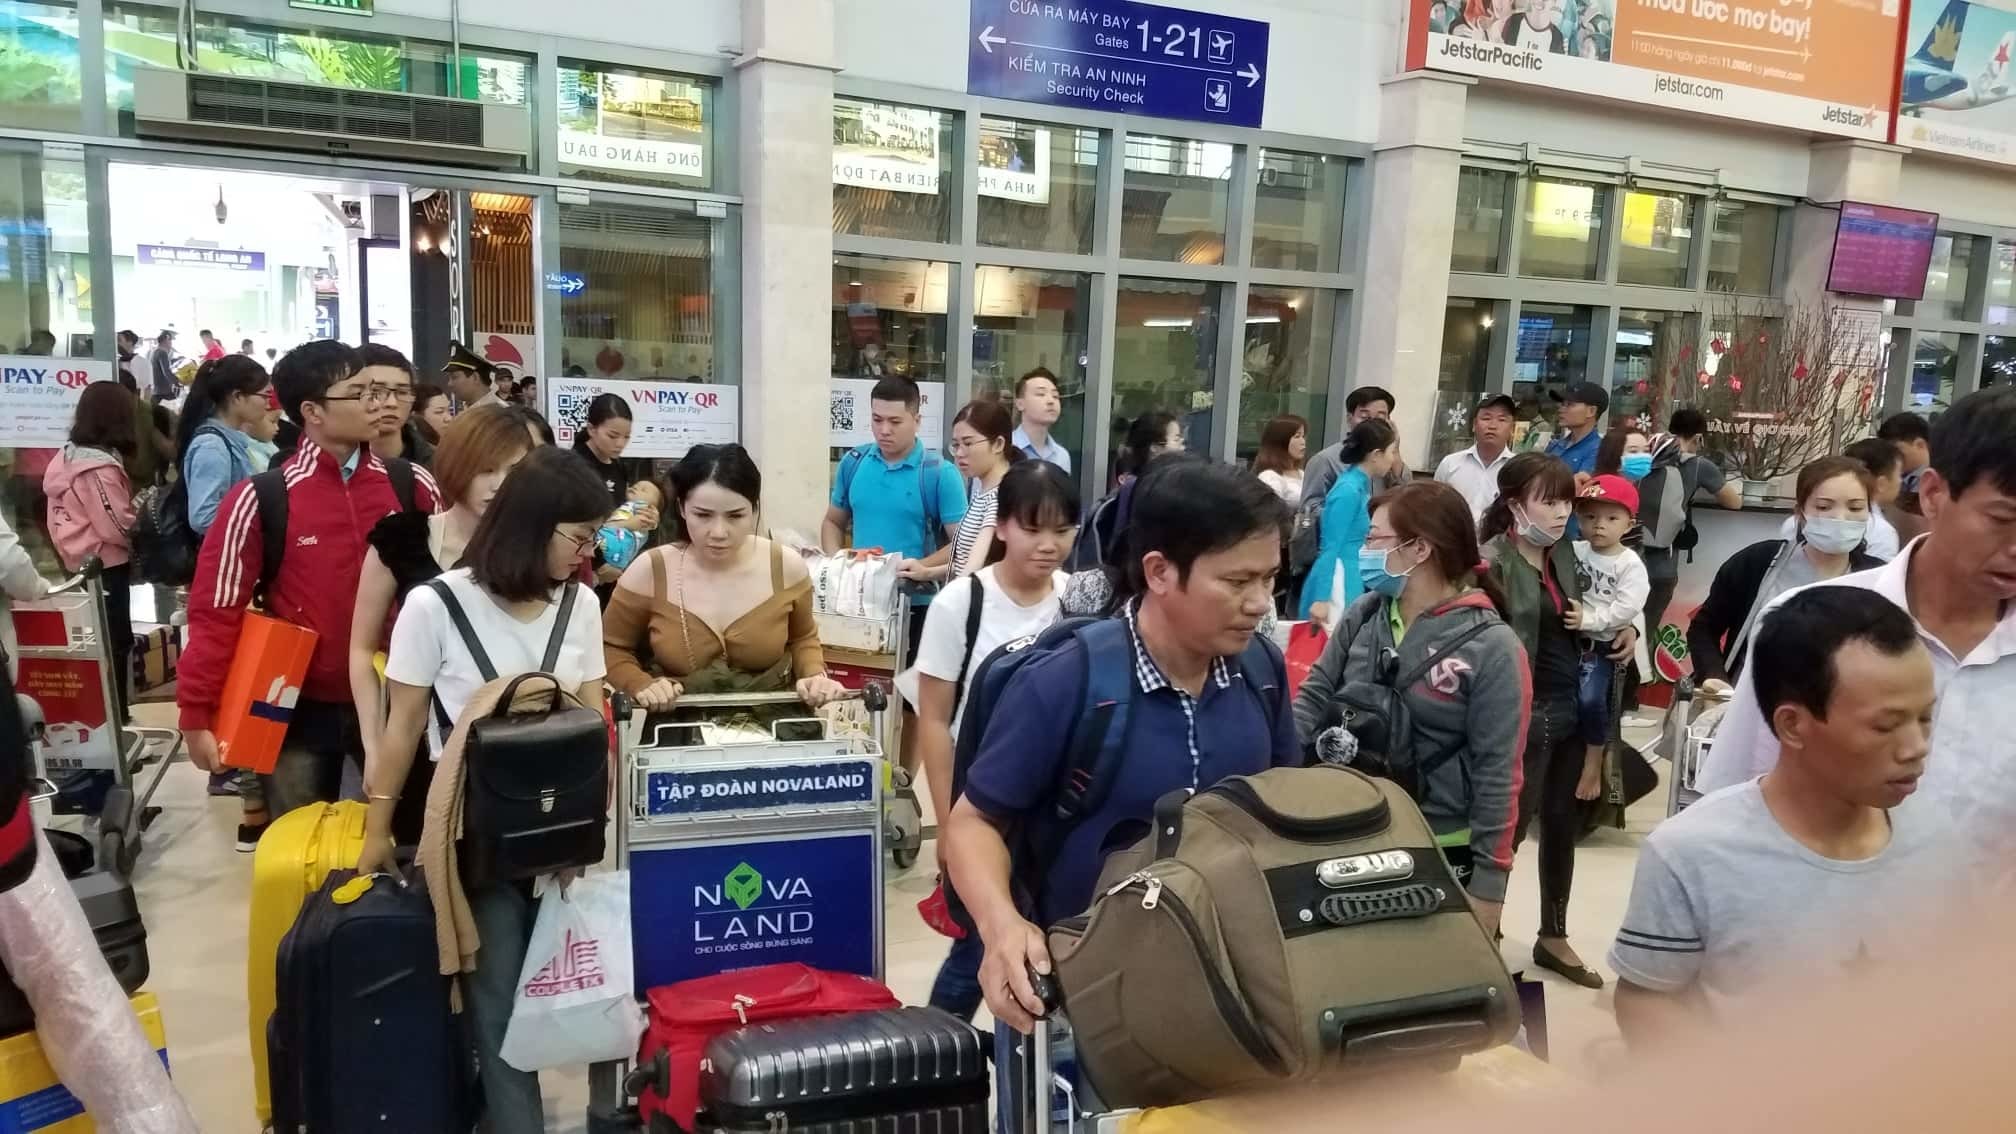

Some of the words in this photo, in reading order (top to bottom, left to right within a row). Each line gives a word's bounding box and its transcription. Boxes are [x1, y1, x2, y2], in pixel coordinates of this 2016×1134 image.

[1045, 5, 1063, 20] RA
[1068, 8, 1098, 25] MÁY
[1103, 14, 1130, 30] BAY
[1769, 8, 1811, 43] bay!
[1095, 33, 1129, 49] Gates
[1137, 20, 1201, 59] 1-21
[1441, 39, 1542, 70] JetstarPacific
[1052, 62, 1081, 78] TRA
[1085, 67, 1106, 81] AN
[1111, 71, 1146, 87] NINH
[1655, 74, 1723, 100] jetstar.com
[1047, 80, 1100, 102] Security
[1103, 88, 1144, 105] Check
[1822, 105, 1863, 127] Jetstar
[632, 390, 718, 408] VNPAY-QR
[657, 783, 695, 802] TẬP
[700, 779, 756, 798] ĐOÀN
[762, 774, 864, 794] NOVALAND
[695, 911, 814, 942] LAND
